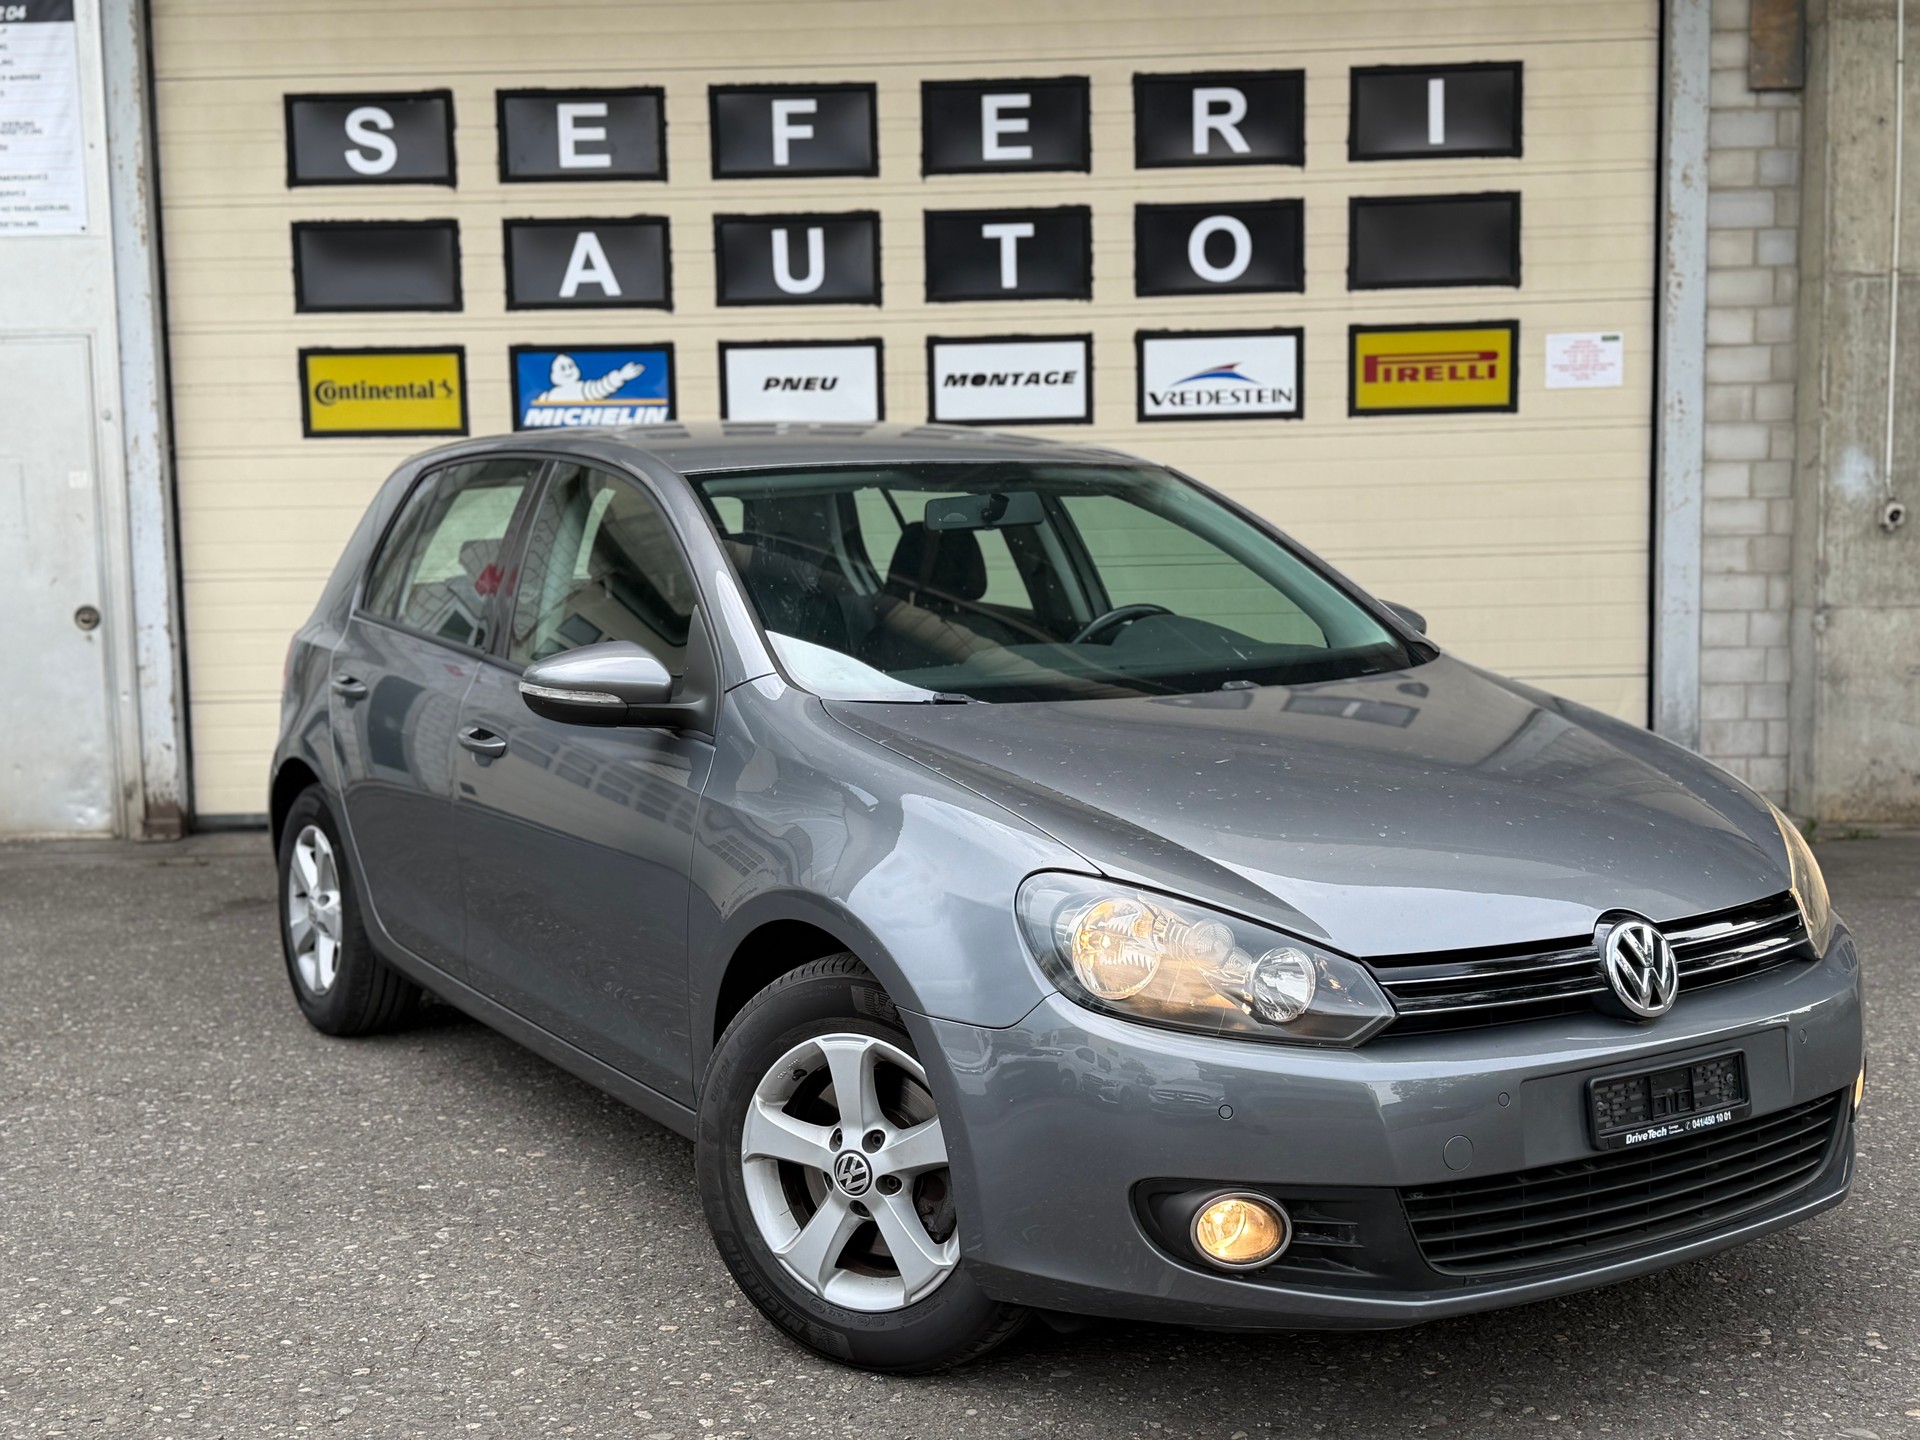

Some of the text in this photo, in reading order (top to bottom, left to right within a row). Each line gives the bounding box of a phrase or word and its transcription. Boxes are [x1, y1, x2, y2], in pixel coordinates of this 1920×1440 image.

[1364, 351, 1499, 383] PIRELLI
[314, 370, 436, 406] Continental
[762, 377, 839, 391] PNEU
[943, 371, 1078, 388] MONTAGE
[1148, 388, 1294, 407] VREDESTEIN
[523, 406, 670, 426] MICHELIN
[1625, 1127, 1667, 1144] DriveTech
[1692, 1114, 1716, 1129] 041/450
[1716, 1113, 1724, 1123] 10
[1724, 1110, 1731, 1120] 01
